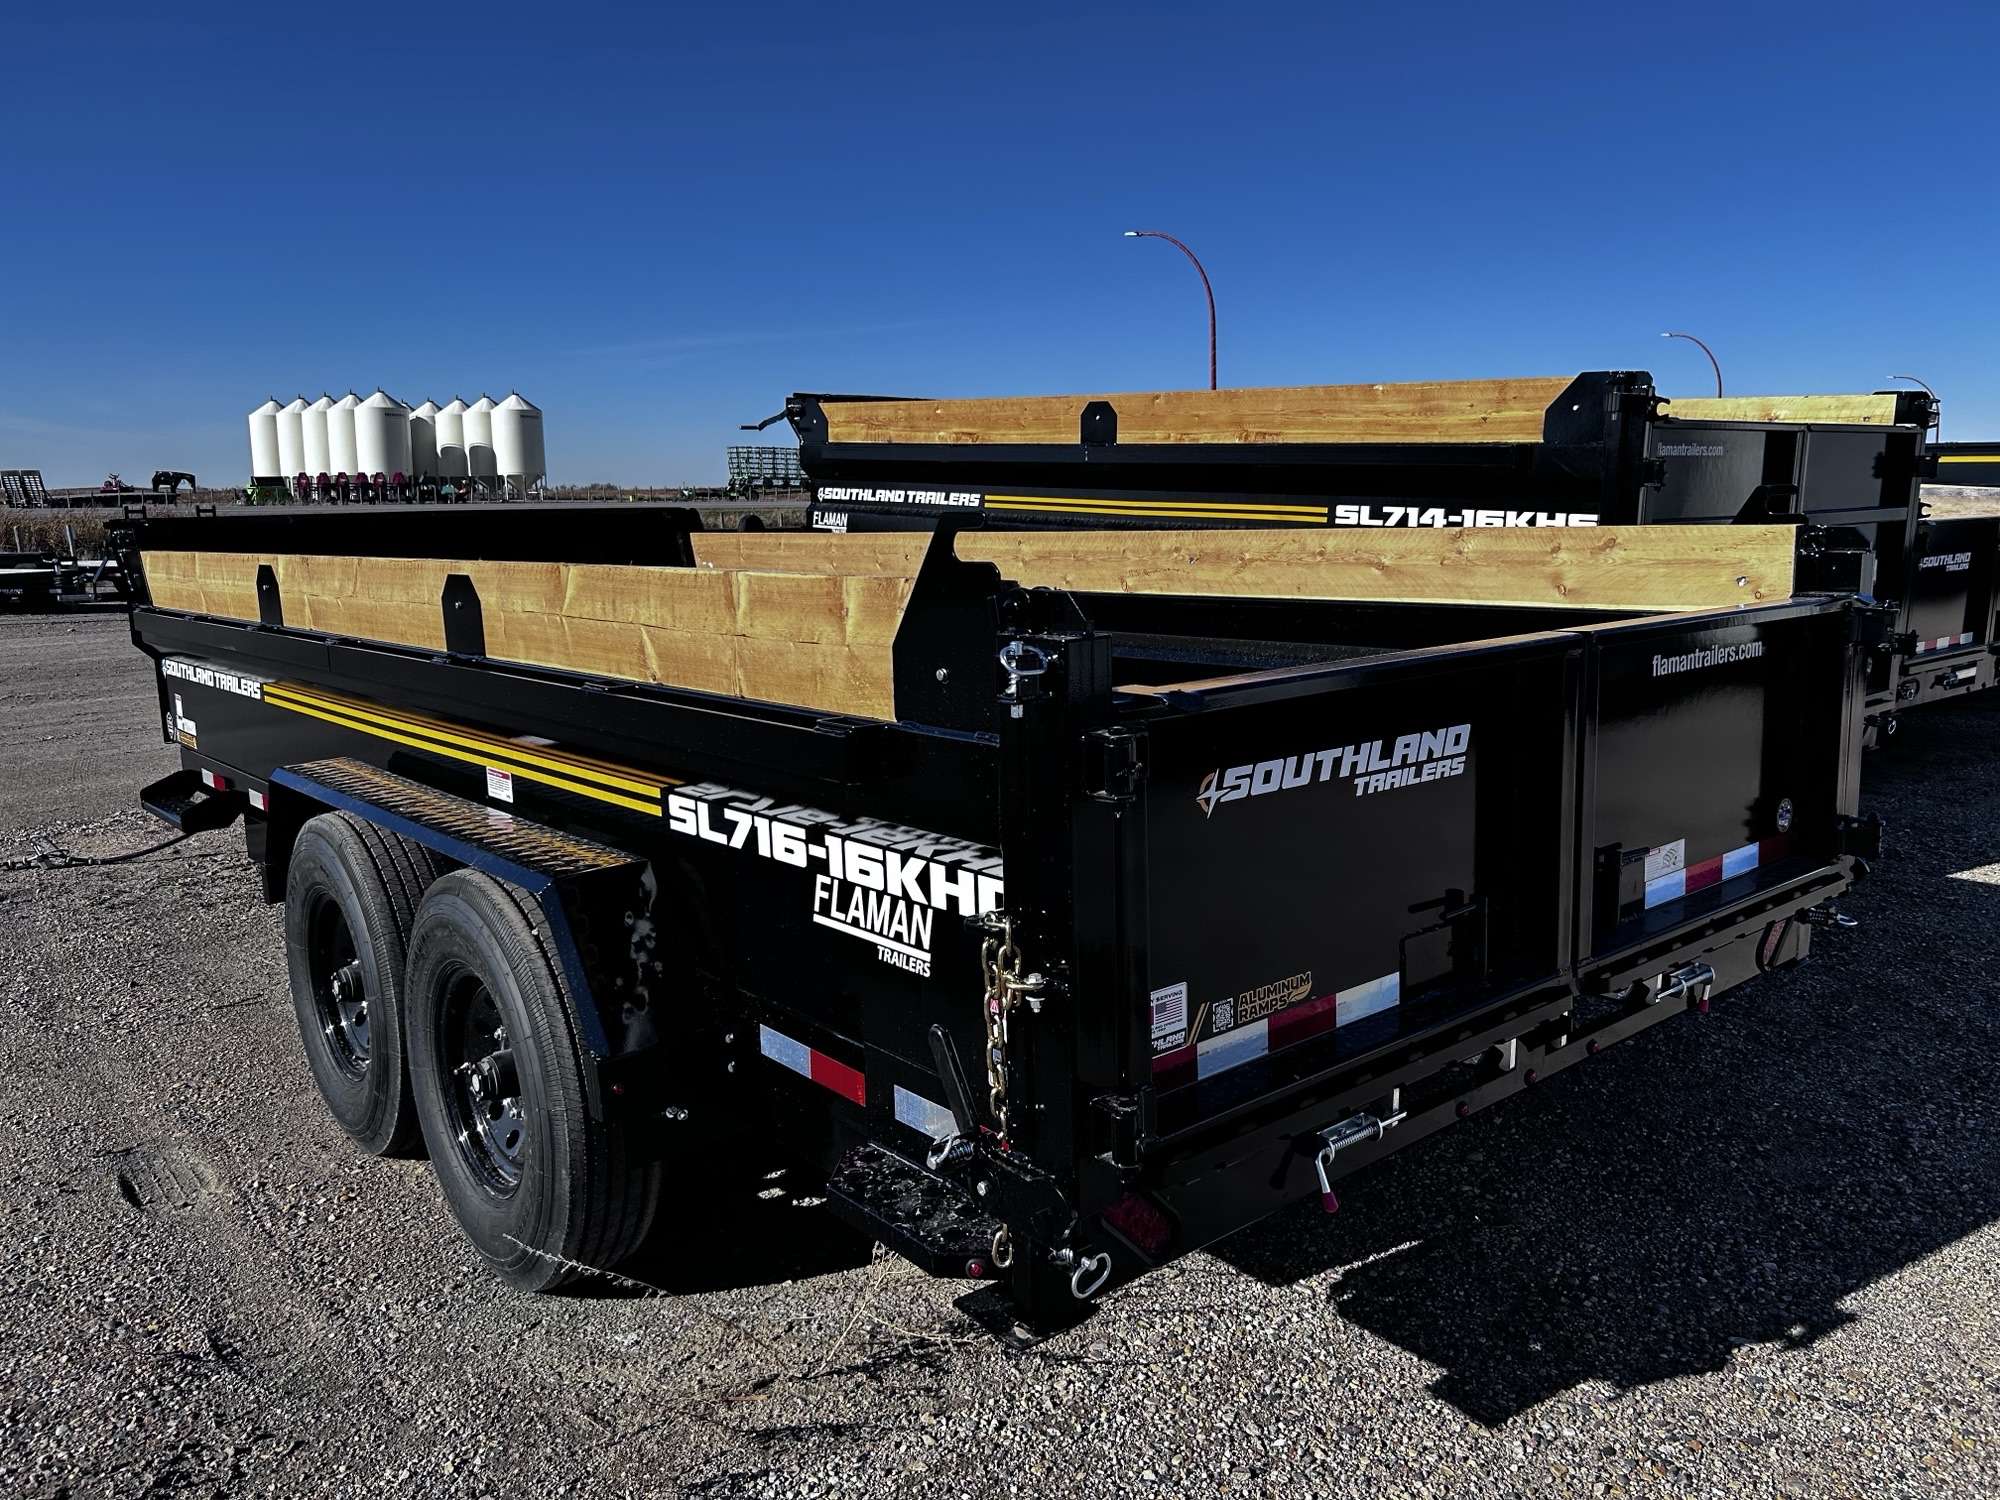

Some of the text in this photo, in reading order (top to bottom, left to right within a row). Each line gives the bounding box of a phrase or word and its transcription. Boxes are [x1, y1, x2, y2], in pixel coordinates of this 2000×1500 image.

[825, 487, 981, 507] SOUTHLAND TRAILERS
[813, 511, 848, 527] FLAMAN
[1923, 552, 1972, 568] SOUTHLAND
[1652, 640, 1763, 678] flamantrailers.com
[165, 659, 261, 700] SOUTHLAND TRAILERS
[1220, 724, 1471, 802] SOUTHLAND
[1353, 755, 1466, 796] TRAILERS
[813, 873, 934, 951] FLAMAN
[877, 944, 931, 978] TRAILERS
[1238, 971, 1312, 1009] ALUMINUM
[1238, 994, 1289, 1024] RAMPS
